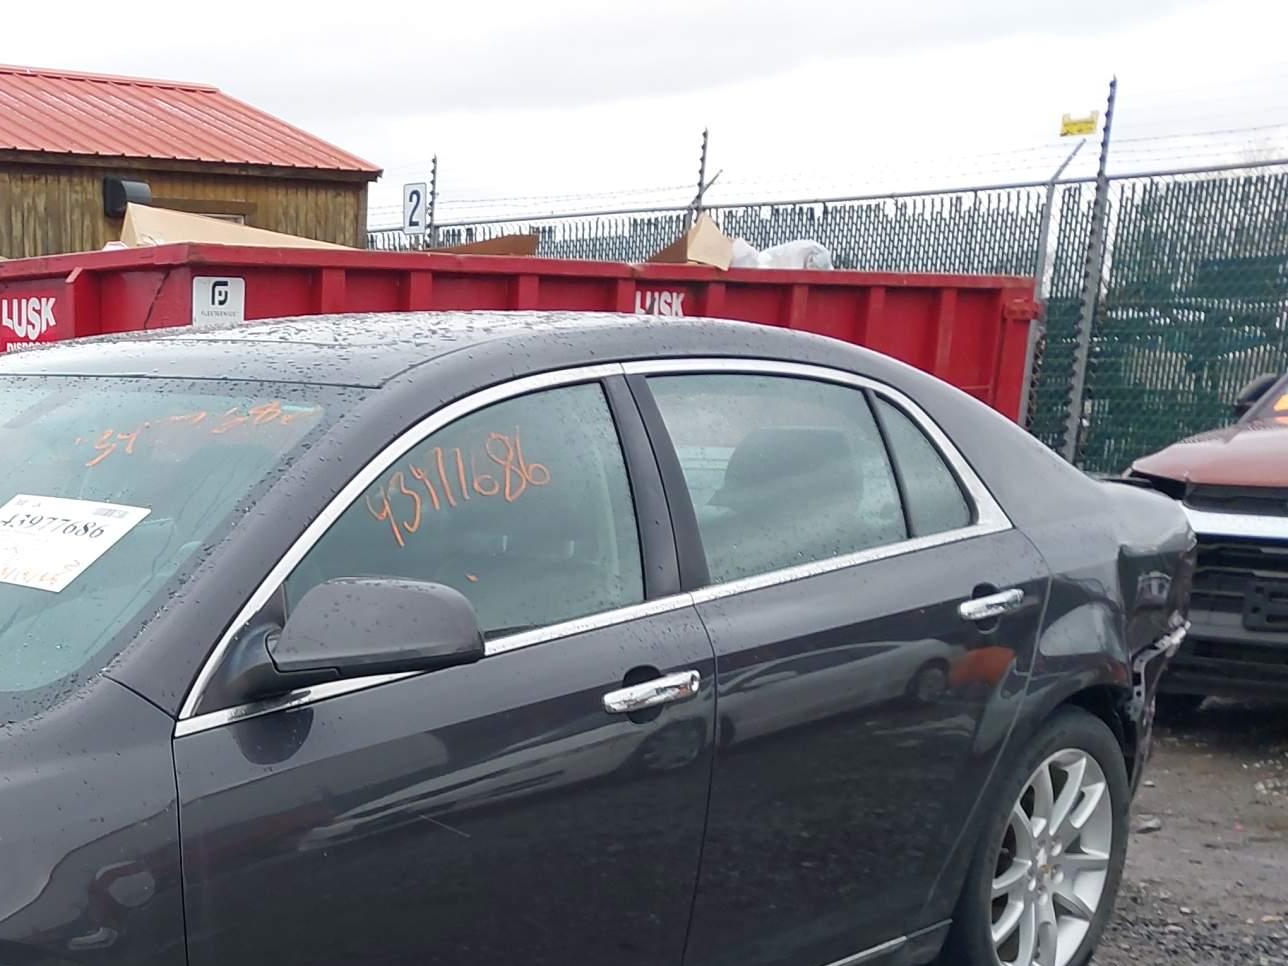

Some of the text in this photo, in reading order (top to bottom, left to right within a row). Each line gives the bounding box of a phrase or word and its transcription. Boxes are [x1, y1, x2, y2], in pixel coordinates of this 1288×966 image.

[408, 188, 421, 227] 2
[2, 297, 56, 341] LUSK
[635, 290, 684, 317] LUSK
